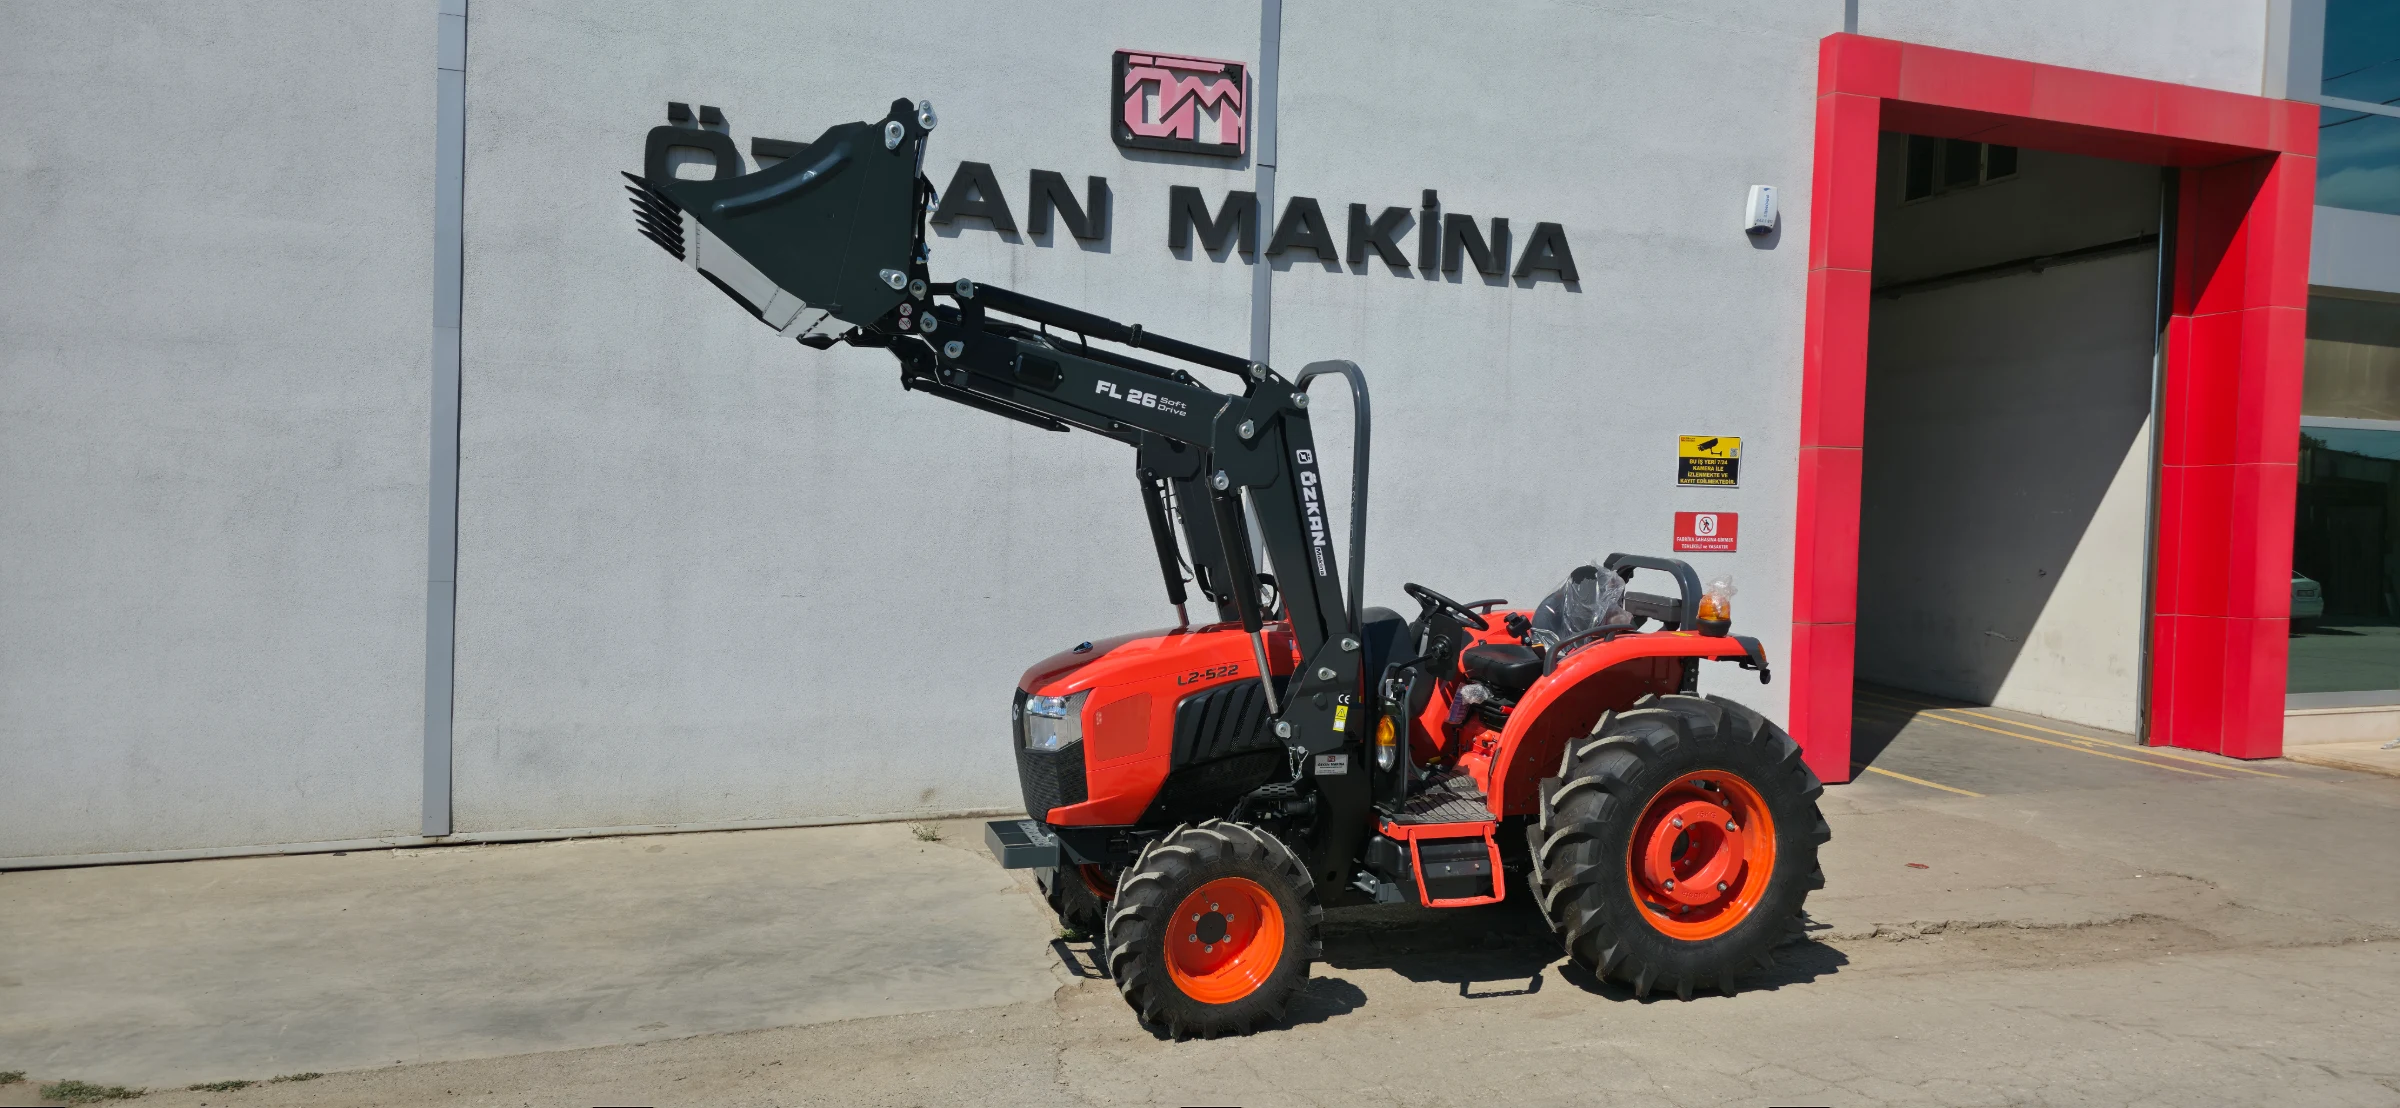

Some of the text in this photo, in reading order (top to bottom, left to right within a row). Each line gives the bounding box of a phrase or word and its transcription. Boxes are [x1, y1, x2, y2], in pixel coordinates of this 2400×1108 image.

[1168, 185, 1579, 281] MAKİNA
[1095, 380, 1157, 408] FL 26
[1160, 396, 1187, 409] Soft
[1157, 404, 1187, 417] Drive
[1300, 471, 1326, 546] ÖZKAN
[1177, 664, 1239, 686] L2-522
